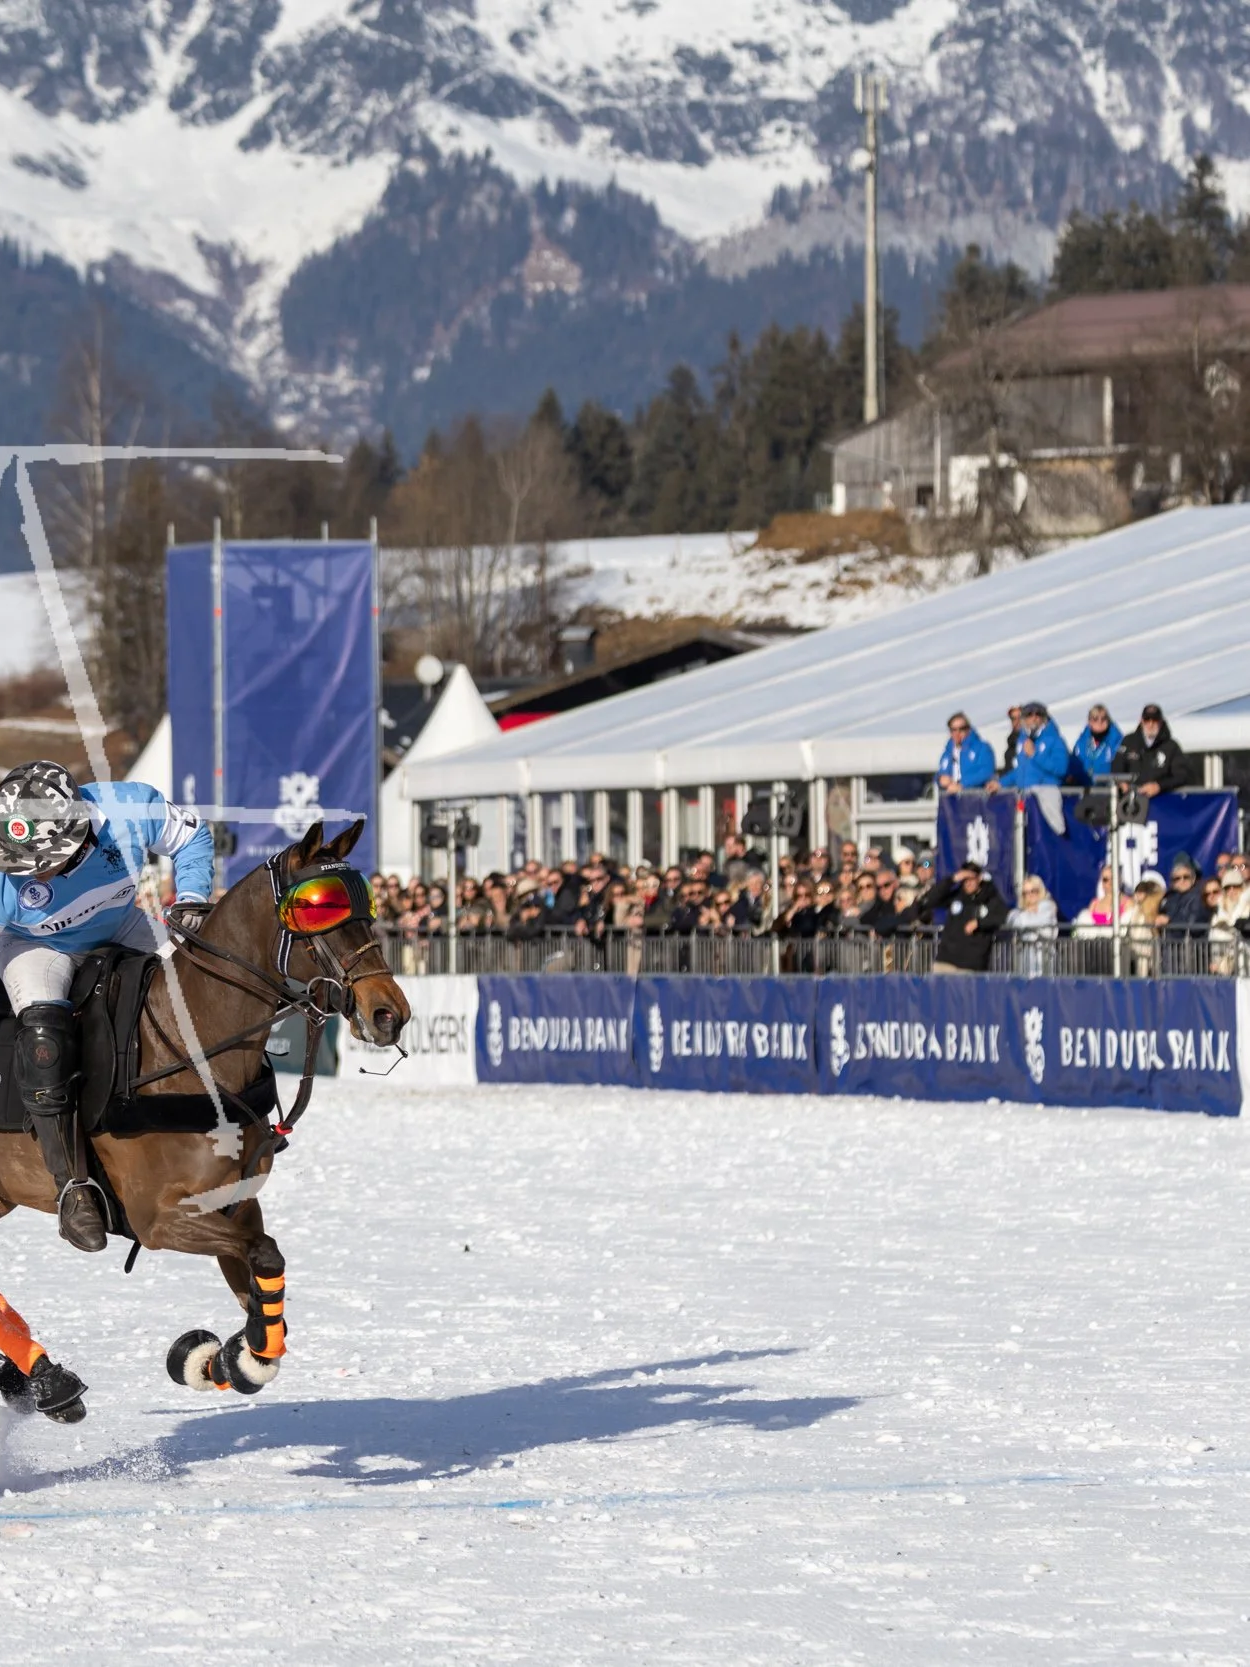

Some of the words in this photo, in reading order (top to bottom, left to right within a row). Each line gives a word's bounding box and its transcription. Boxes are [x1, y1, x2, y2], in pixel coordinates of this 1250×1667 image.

[508, 1016, 582, 1051] BENDURA
[751, 1022, 807, 1060] BANK
[945, 1023, 1000, 1063] BANK
[1060, 1027, 1164, 1071] BENDURA
[1168, 1029, 1230, 1072] BANK
